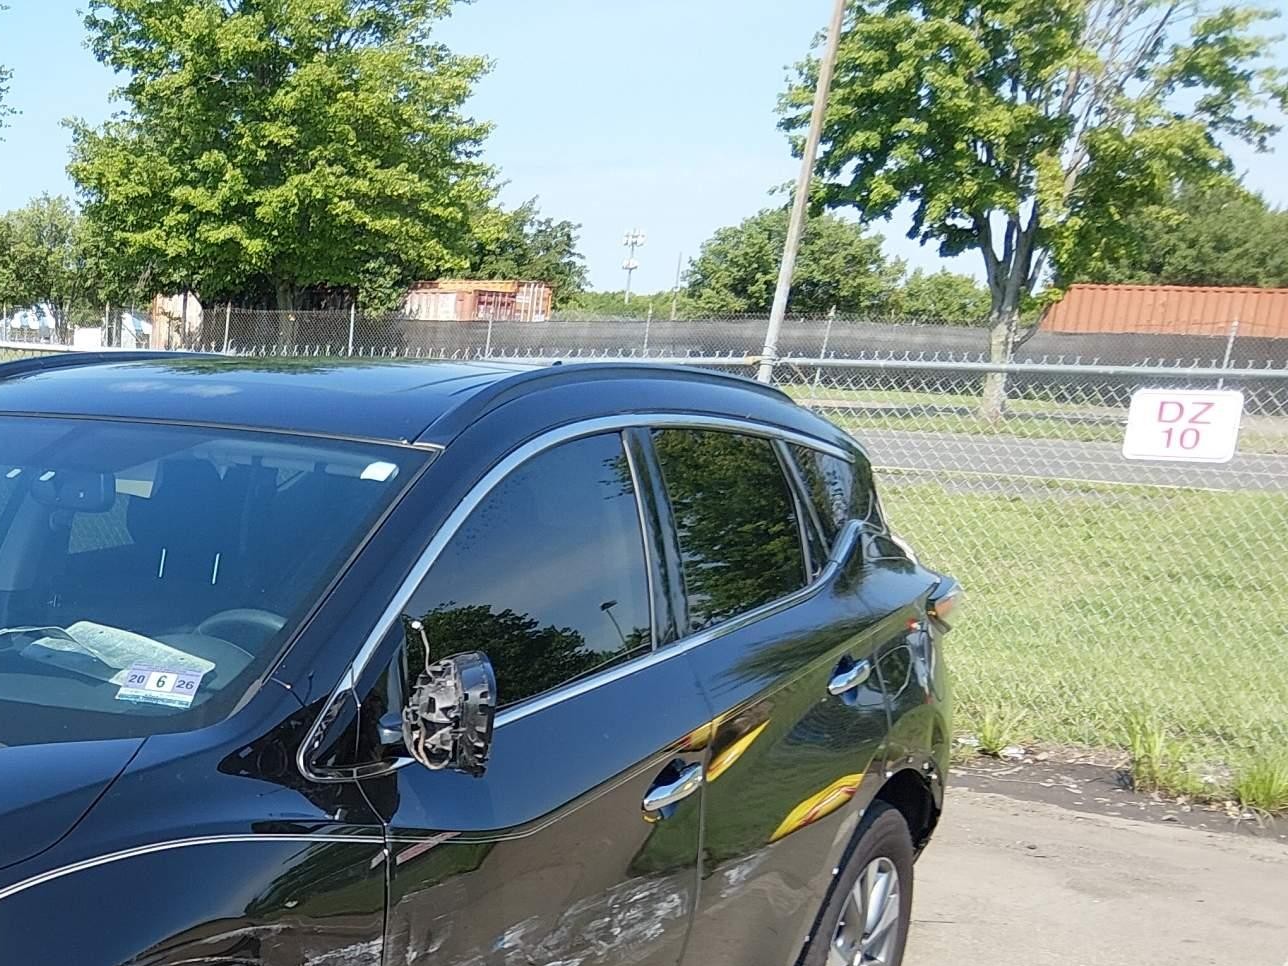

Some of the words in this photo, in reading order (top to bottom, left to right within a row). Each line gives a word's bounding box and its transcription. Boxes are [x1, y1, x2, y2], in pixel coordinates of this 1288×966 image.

[1157, 401, 1216, 424] DZ
[1161, 427, 1201, 450] 10
[128, 674, 146, 684] 20
[156, 675, 168, 688] 6
[175, 680, 195, 690] 26
